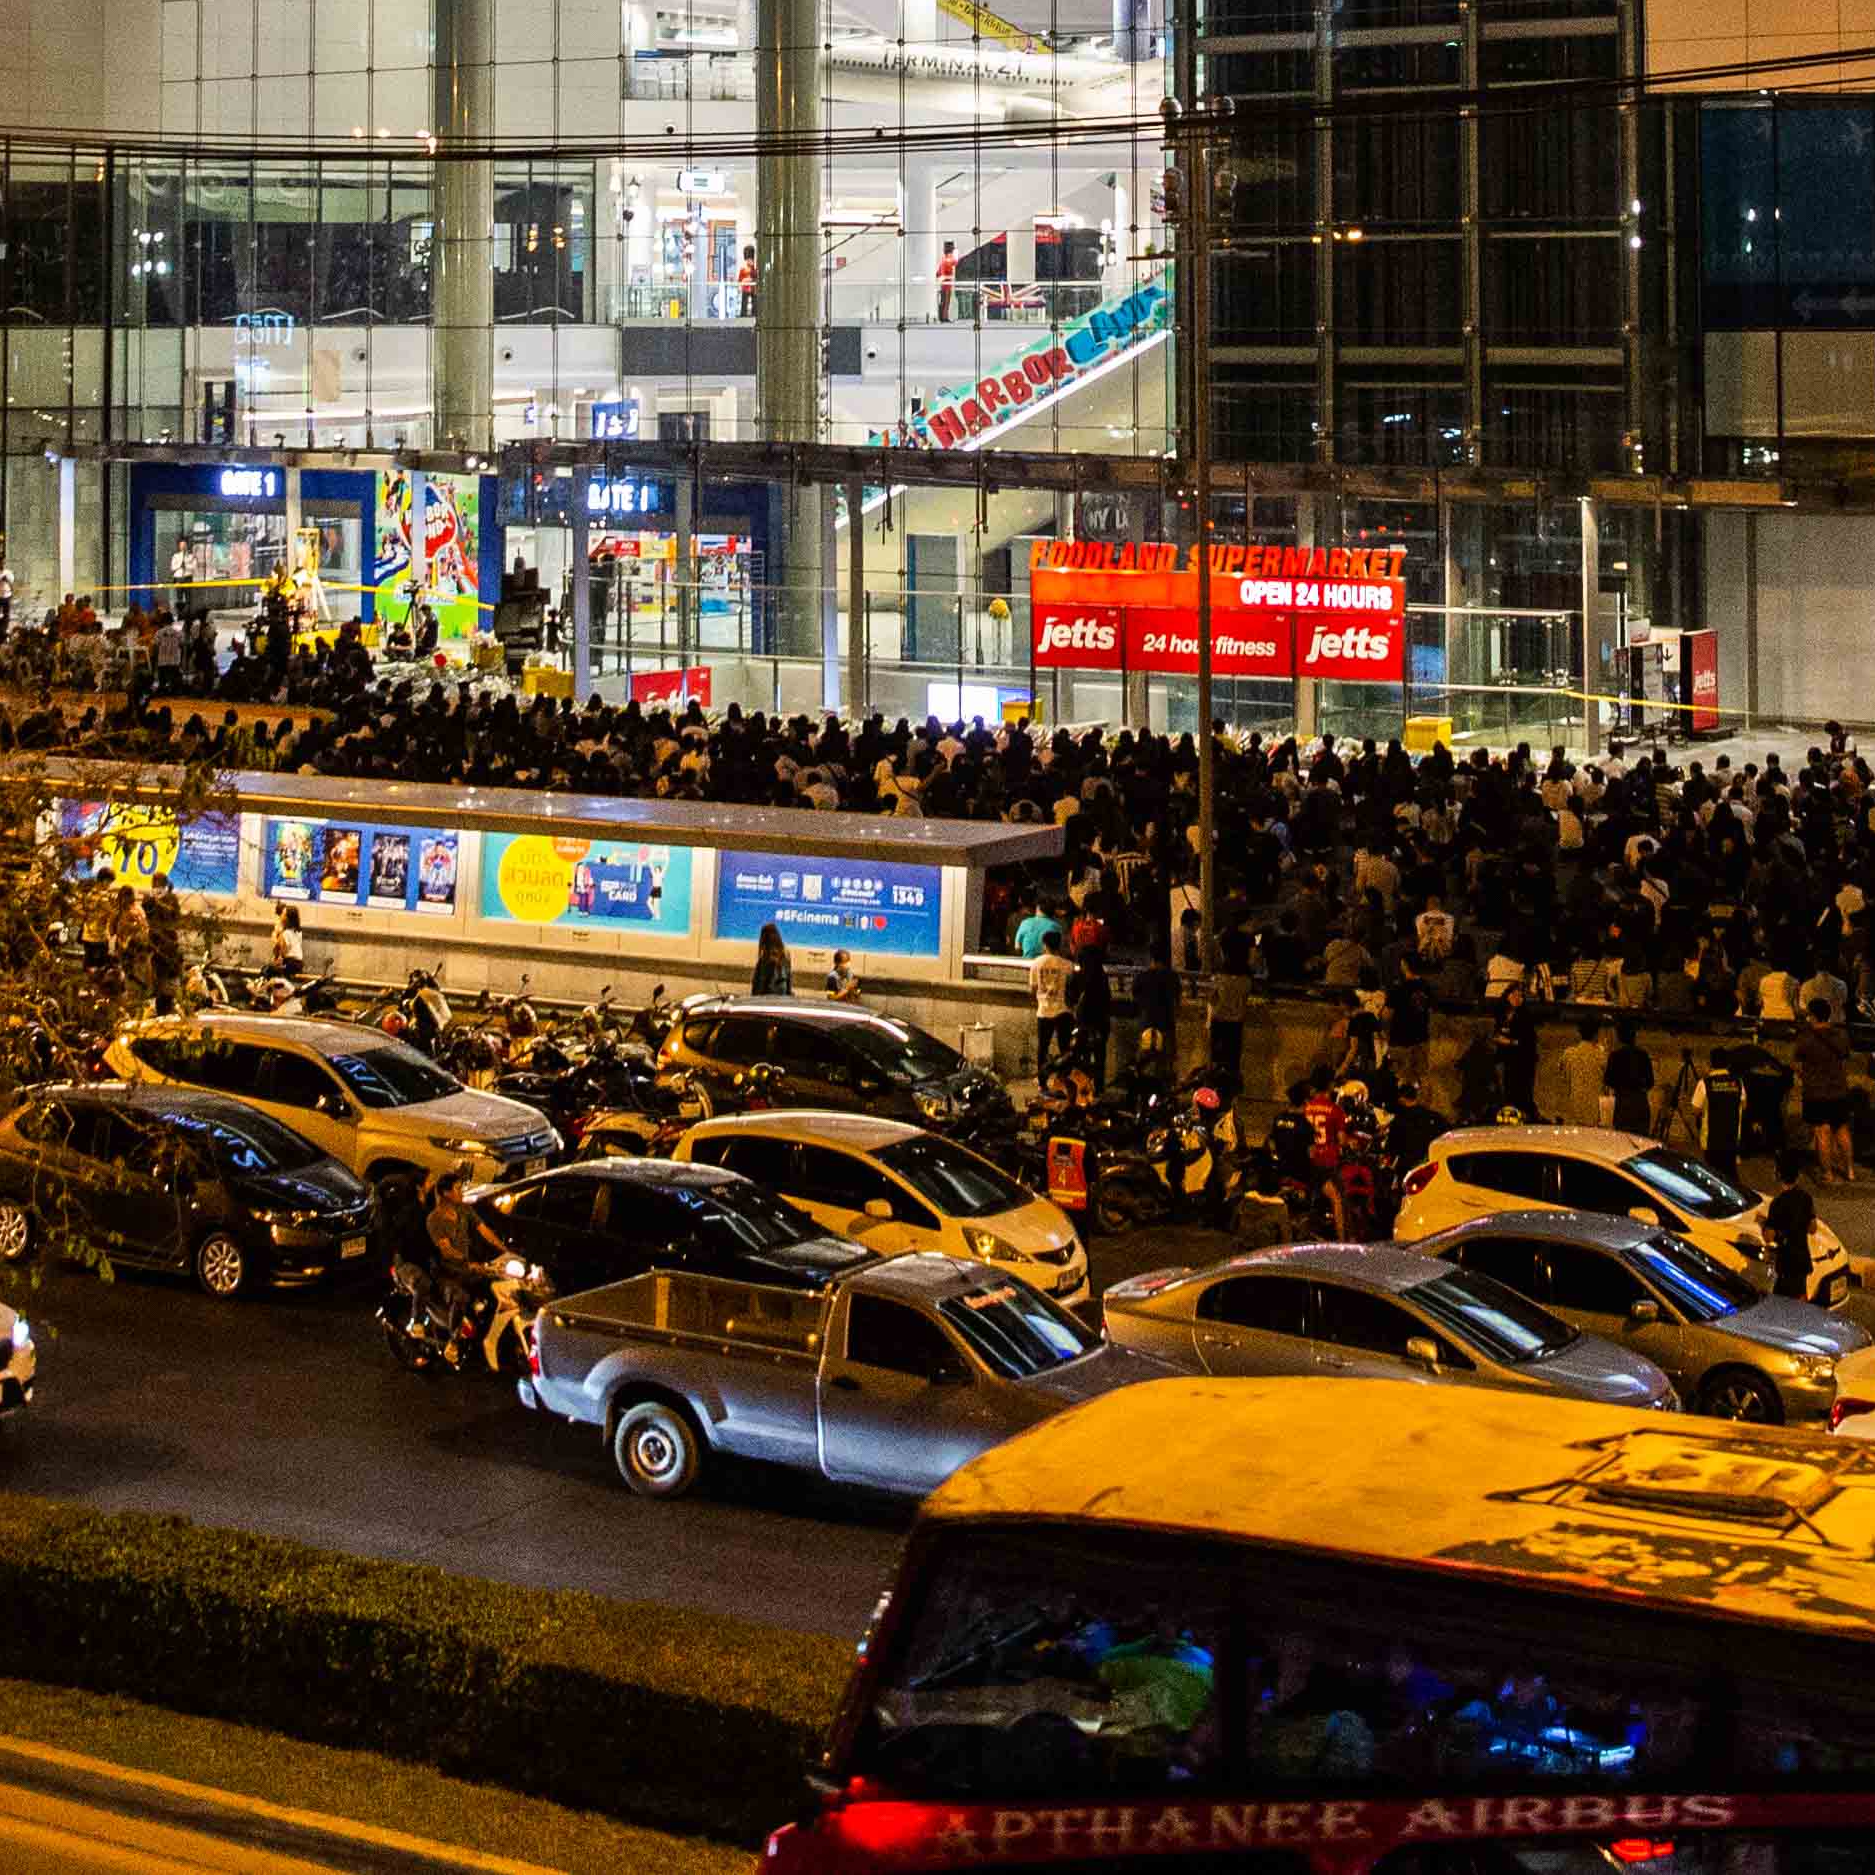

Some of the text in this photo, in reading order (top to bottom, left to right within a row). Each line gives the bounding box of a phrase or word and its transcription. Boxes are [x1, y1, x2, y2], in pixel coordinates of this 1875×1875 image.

[927, 346, 1075, 450] HARBOR
[1030, 541, 1407, 579] FOODLAND SUPERMARKET
[1240, 580, 1393, 611] OPEN 24 HOURS
[1037, 616, 1116, 654] jetts
[1142, 634, 1276, 657] 24 hou fitness
[1305, 625, 1391, 664] jetts
[1398, 1791, 1734, 1837] AIRBUS
